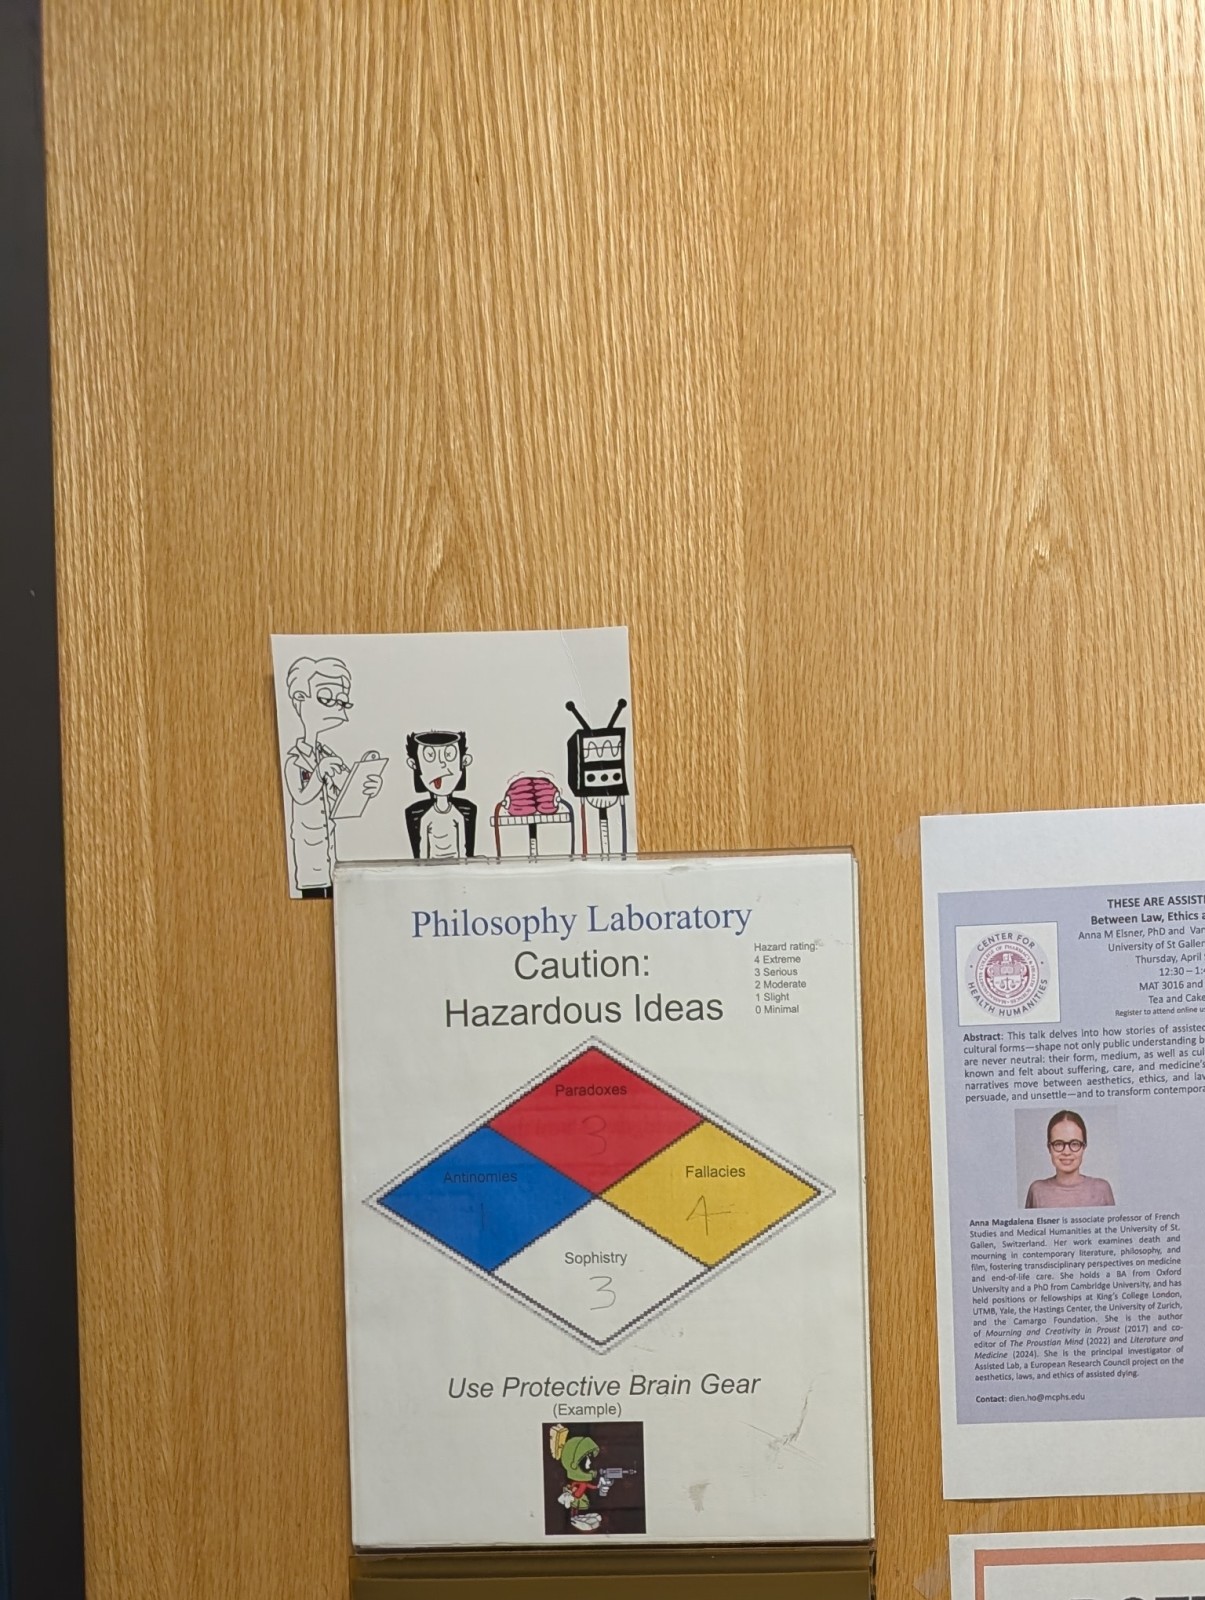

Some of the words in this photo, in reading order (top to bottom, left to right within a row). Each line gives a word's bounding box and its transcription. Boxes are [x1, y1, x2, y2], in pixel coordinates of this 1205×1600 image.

[1107, 898, 1140, 908] THESE
[1144, 897, 1164, 906] ARE
[413, 907, 576, 942] Philosophy
[588, 904, 752, 936] Laboratory
[1091, 916, 1138, 925] Between
[1141, 914, 1164, 923] Law,
[1168, 911, 1198, 921] Ethics
[754, 942, 786, 951] Hazard
[790, 941, 817, 952] rating:
[763, 955, 801, 964] Extreme
[1135, 954, 1178, 963] Thursday,
[1181, 952, 1201, 963] April
[515, 950, 648, 980] Caution:
[764, 968, 798, 976] Serious
[764, 980, 806, 988] Moderate
[1139, 982, 1159, 990] MAT
[1162, 980, 1184, 990] 3016
[1187, 980, 1203, 988] and
[764, 992, 789, 1003] Slight
[1148, 995, 1163, 1004] Tea
[1166, 994, 1183, 1003] and
[446, 996, 621, 1027] Hazardous
[636, 994, 723, 1022] Ideas
[764, 1005, 799, 1013] Minimal
[555, 1084, 627, 1096] Paradoxes
[444, 1170, 517, 1183] Antinomies
[686, 1165, 745, 1178] Fallacies
[565, 1252, 627, 1266] Sophistry
[589, 1276, 617, 1310] 3
[449, 1378, 493, 1398] Use
[503, 1376, 620, 1397] Protective
[629, 1375, 691, 1395] Brain
[701, 1373, 761, 1394] Gear
[553, 1403, 622, 1418] (Example)
